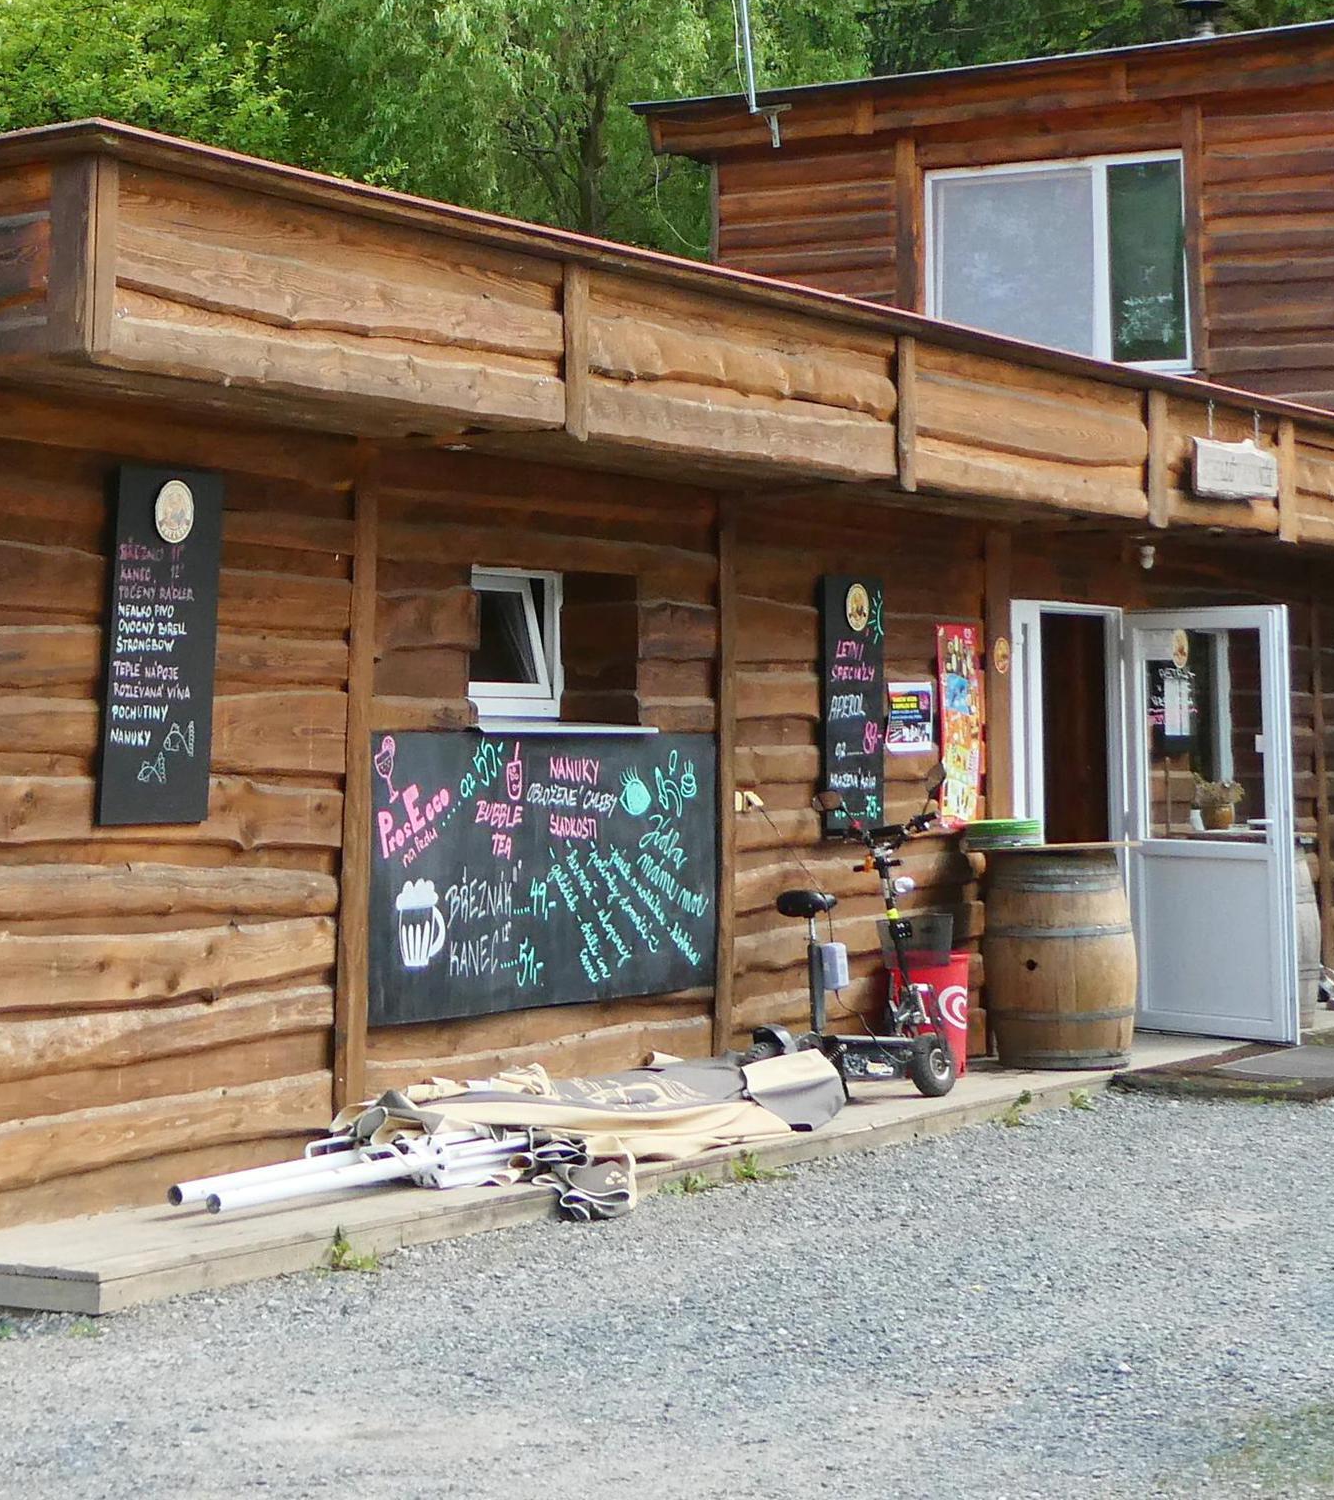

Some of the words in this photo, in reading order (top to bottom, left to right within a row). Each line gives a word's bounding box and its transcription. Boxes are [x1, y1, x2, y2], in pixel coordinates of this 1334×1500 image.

[118, 602, 153, 618] NEALKO
[154, 604, 175, 618] PIVO
[118, 617, 155, 635] OVOCNÝ
[115, 635, 175, 654] STRONGBOW
[113, 656, 142, 677] TEPLÉ
[145, 661, 179, 680] NÁPOJE
[112, 704, 169, 722] POCHUTINY
[828, 692, 867, 721] APEROL
[110, 727, 152, 746] NANUKY
[550, 756, 599, 786] NANUKY
[475, 800, 523, 829] BUBBLE
[549, 813, 597, 840] SLADKOSTI
[492, 832, 513, 860] TEA
[450, 930, 498, 977] KANEC
